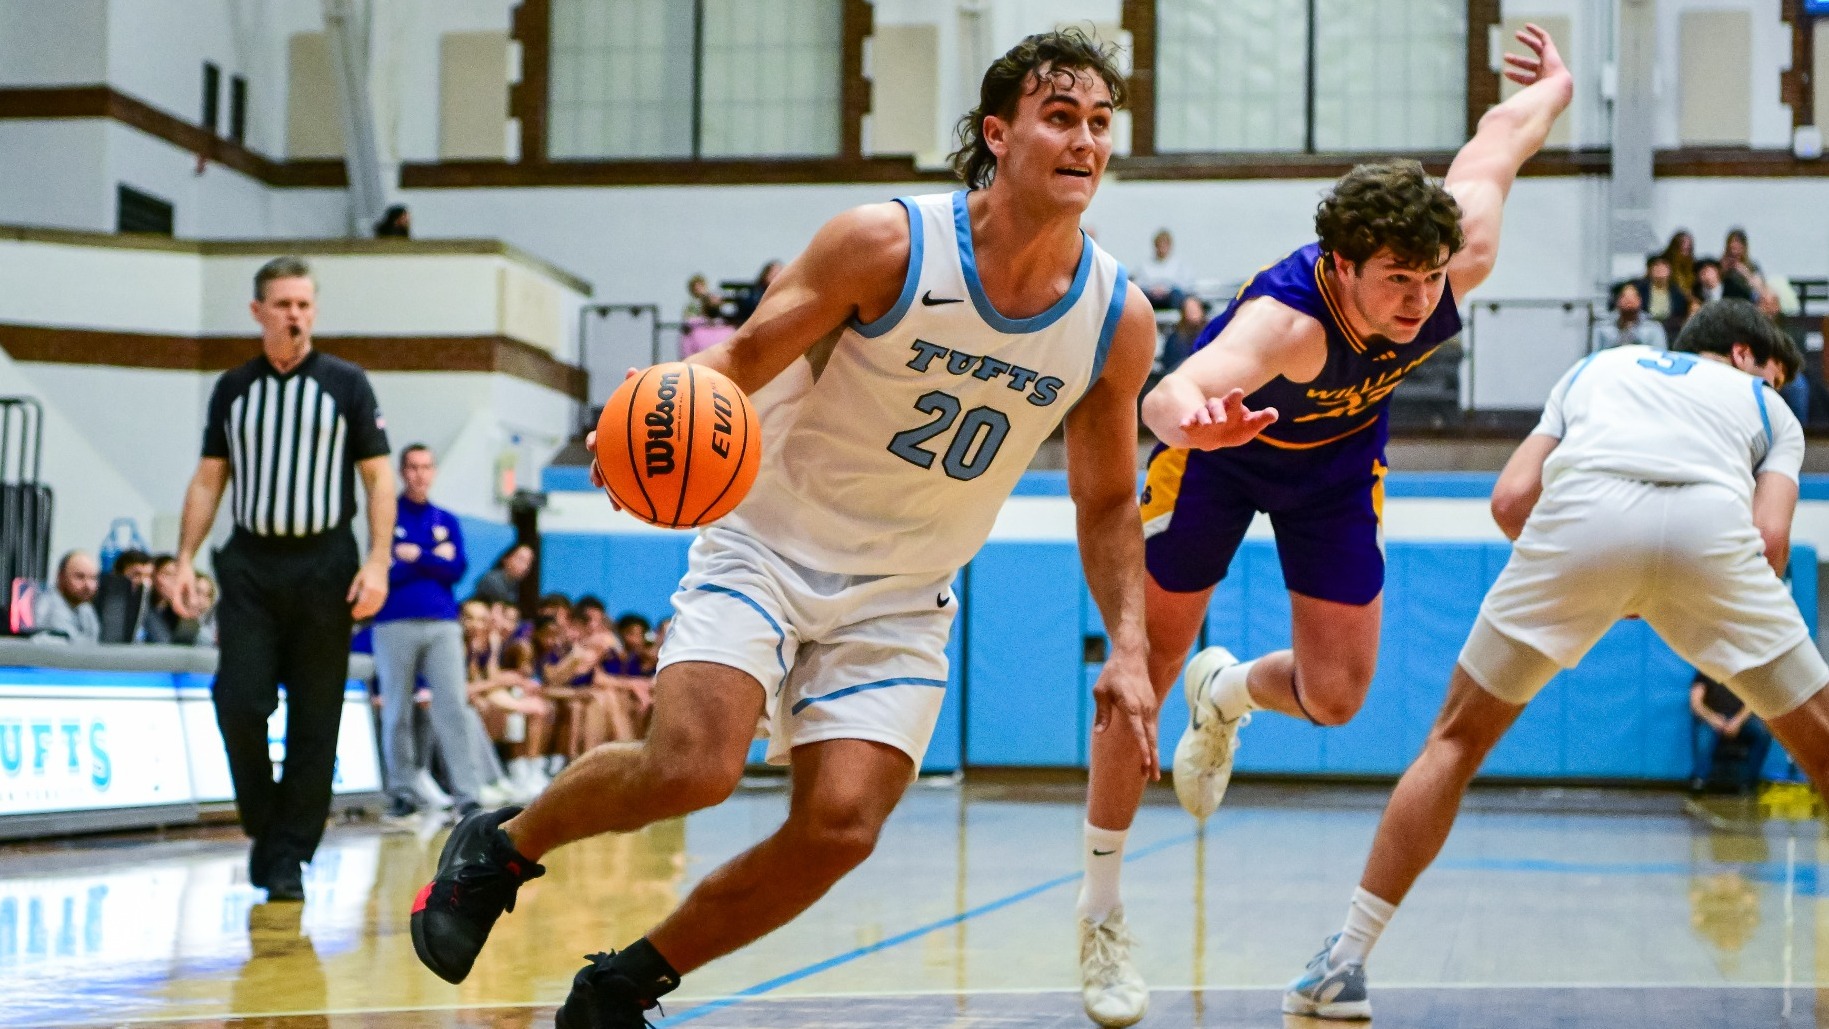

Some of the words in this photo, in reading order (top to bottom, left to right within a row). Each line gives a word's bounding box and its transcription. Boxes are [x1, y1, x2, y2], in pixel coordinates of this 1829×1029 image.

[906, 338, 1065, 406] TUFTS
[645, 372, 681, 478] Wilson
[886, 390, 1011, 481] 20
